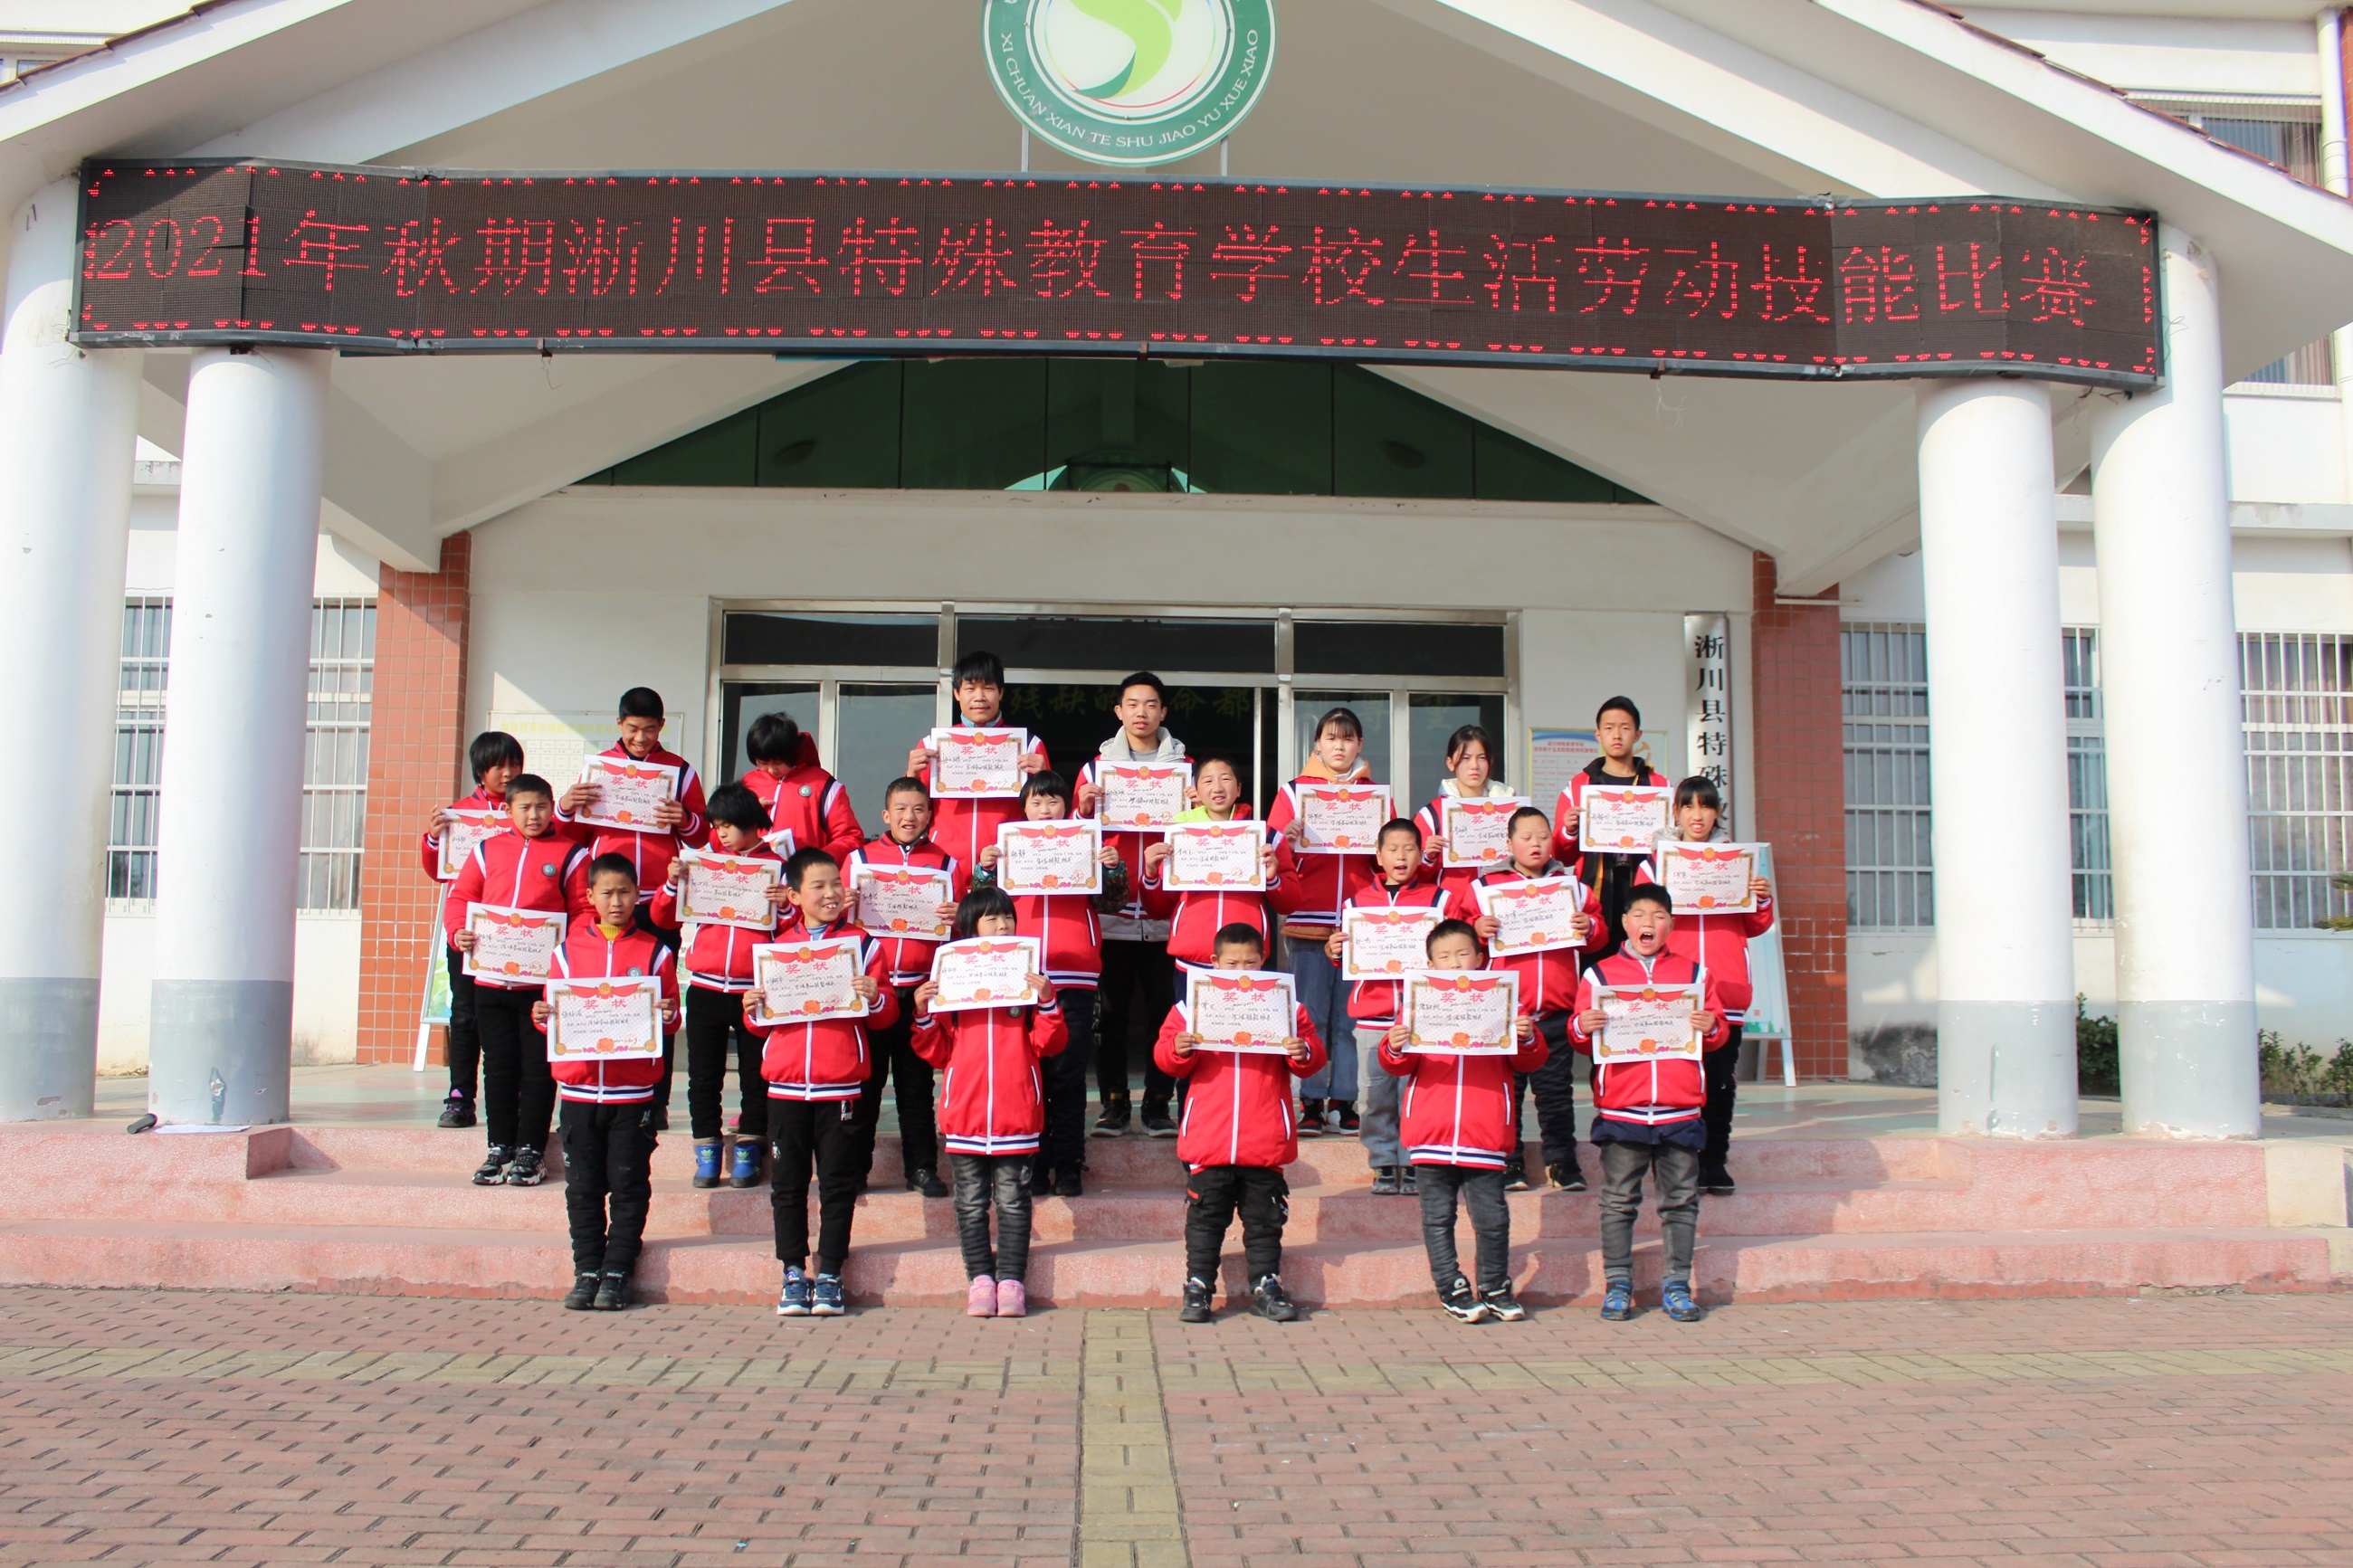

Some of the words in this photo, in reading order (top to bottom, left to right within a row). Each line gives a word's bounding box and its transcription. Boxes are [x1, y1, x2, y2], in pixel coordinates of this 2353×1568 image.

[1001, 32, 1014, 54] XI
[1241, 29, 1259, 78] XIAO
[1005, 57, 1047, 116] CHUAN
[1219, 78, 1248, 114] XUE
[1197, 109, 1222, 128] YU
[1045, 111, 1086, 138] XIAN
[1090, 131, 1111, 147] TE
[1158, 125, 1196, 146] JIAO
[1116, 136, 1154, 147] SHU
[95, 209, 2098, 326] 2021年秋期淅川县特殊教育学校生活劳动技能比赛
[1695, 635, 1729, 834] 淅川县特殊
[960, 746, 998, 755] 奖状
[611, 775, 649, 789] 奖状
[1125, 779, 1163, 789] 奖状
[1325, 802, 1362, 811] 奖状
[1610, 803, 1647, 813] 奖状
[1472, 815, 1507, 824] 奖状
[1030, 839, 1071, 849] 奖状
[1196, 838, 1236, 847] 奖状
[1689, 861, 1729, 871] 奖状
[710, 872, 749, 884] 奖状
[882, 883, 922, 895] 奖状
[1515, 897, 1553, 908] 奖状
[496, 926, 534, 938] 奖状
[1375, 925, 1414, 935] 奖状
[964, 955, 1006, 965] 奖状
[786, 961, 830, 974] 奖状
[1223, 992, 1267, 1003] 奖状
[1440, 992, 1485, 1003] 奖状
[583, 999, 628, 1010] 奖状
[1627, 1002, 1671, 1012] 奖状
